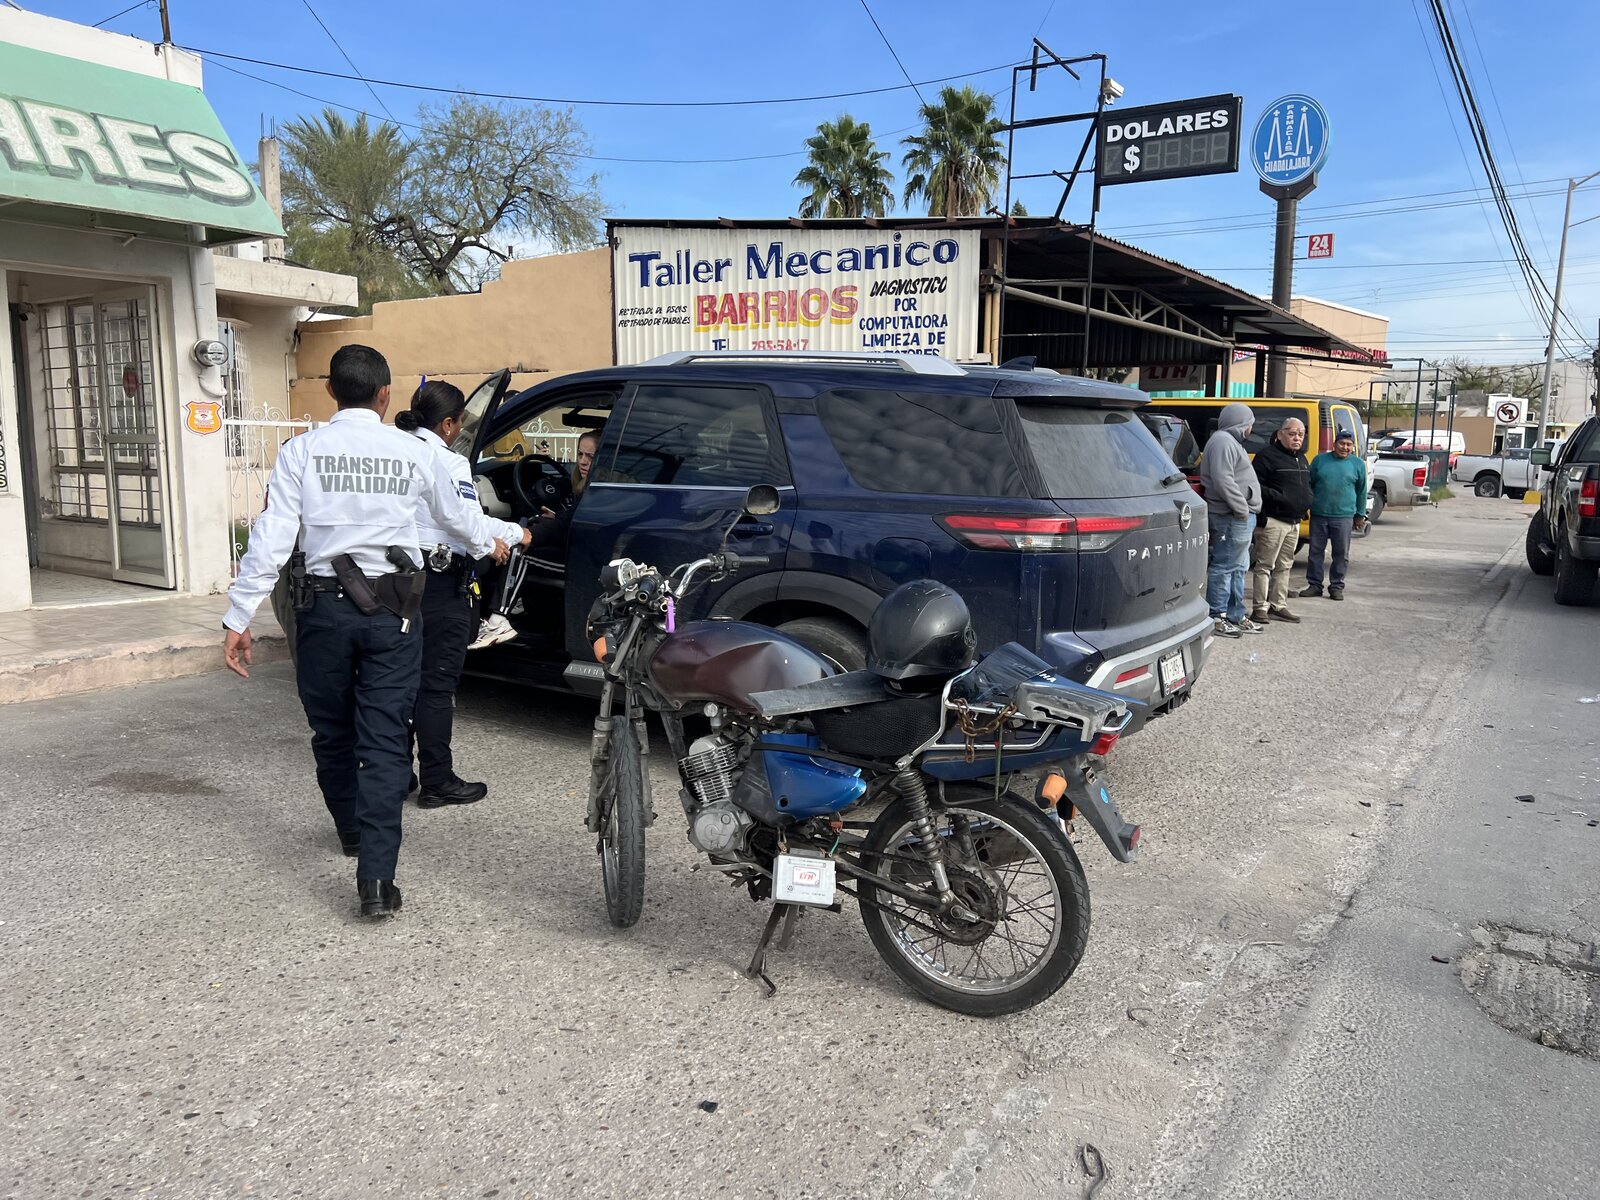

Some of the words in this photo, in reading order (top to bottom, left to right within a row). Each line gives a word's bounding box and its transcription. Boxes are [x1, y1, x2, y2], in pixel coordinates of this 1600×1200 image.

[1106, 109, 1229, 143] DOLARES
[1284, 104, 1295, 152] FARMACIAS
[1123, 144, 1141, 174] $
[1264, 155, 1311, 173] GUADALAJARA
[1311, 235, 1329, 250] 24
[629, 248, 733, 288] Taller
[746, 231, 960, 280] Mecanico
[694, 284, 859, 332] BARRIOS
[894, 297, 918, 312] POR
[859, 314, 949, 331] COMPUTADORA
[862, 332, 920, 347] LIMPIEZA
[928, 331, 946, 345] DE
[313, 453, 403, 477] TRÁNSITO
[407, 461, 417, 479] Y
[319, 474, 410, 496] VIALIDAD
